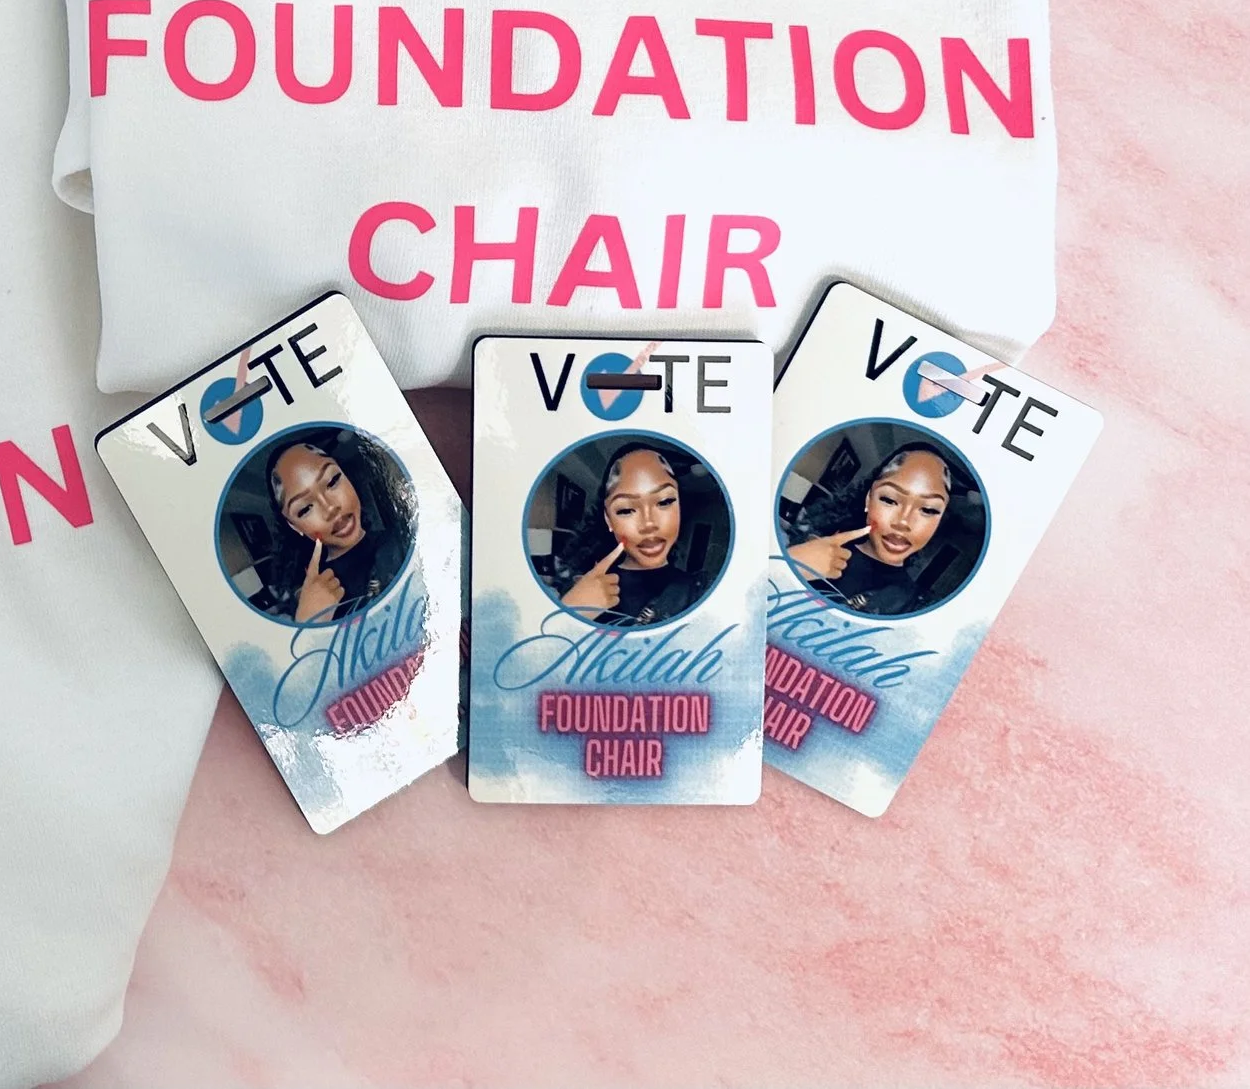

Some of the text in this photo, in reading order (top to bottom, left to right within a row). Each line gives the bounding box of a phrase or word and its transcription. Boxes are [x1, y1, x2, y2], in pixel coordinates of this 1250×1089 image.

[348, 201, 782, 309] CHAIR
[493, 605, 740, 691] Akilah
[540, 693, 710, 734] FOUNDATION
[764, 694, 812, 750] AIR
[765, 645, 877, 734] NDATION
[585, 738, 663, 777] CHAIR
